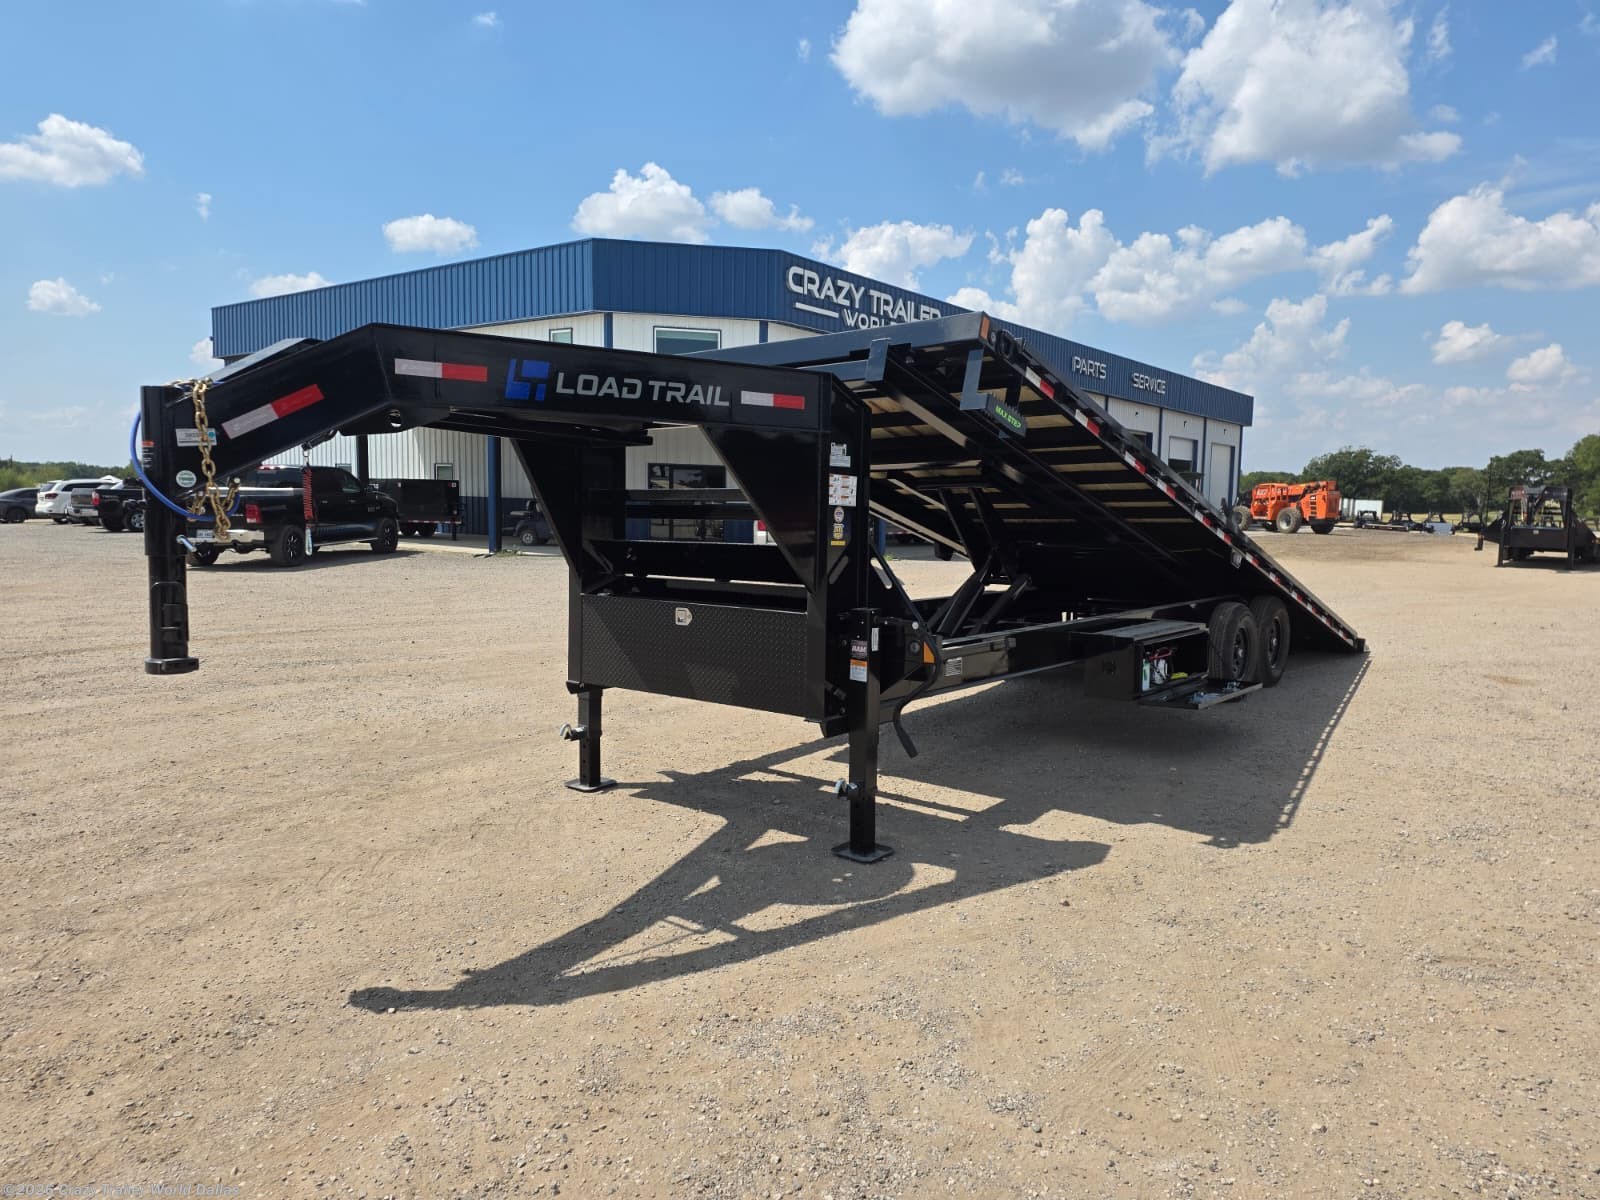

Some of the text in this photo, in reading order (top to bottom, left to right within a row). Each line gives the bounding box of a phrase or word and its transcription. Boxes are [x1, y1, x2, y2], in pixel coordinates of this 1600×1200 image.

[788, 266, 865, 309] CRAZY
[843, 308, 896, 330] WOR
[1072, 356, 1107, 379] PARTS
[556, 372, 730, 407] LOAD TRAIL
[1132, 373, 1166, 394] SERVICE
